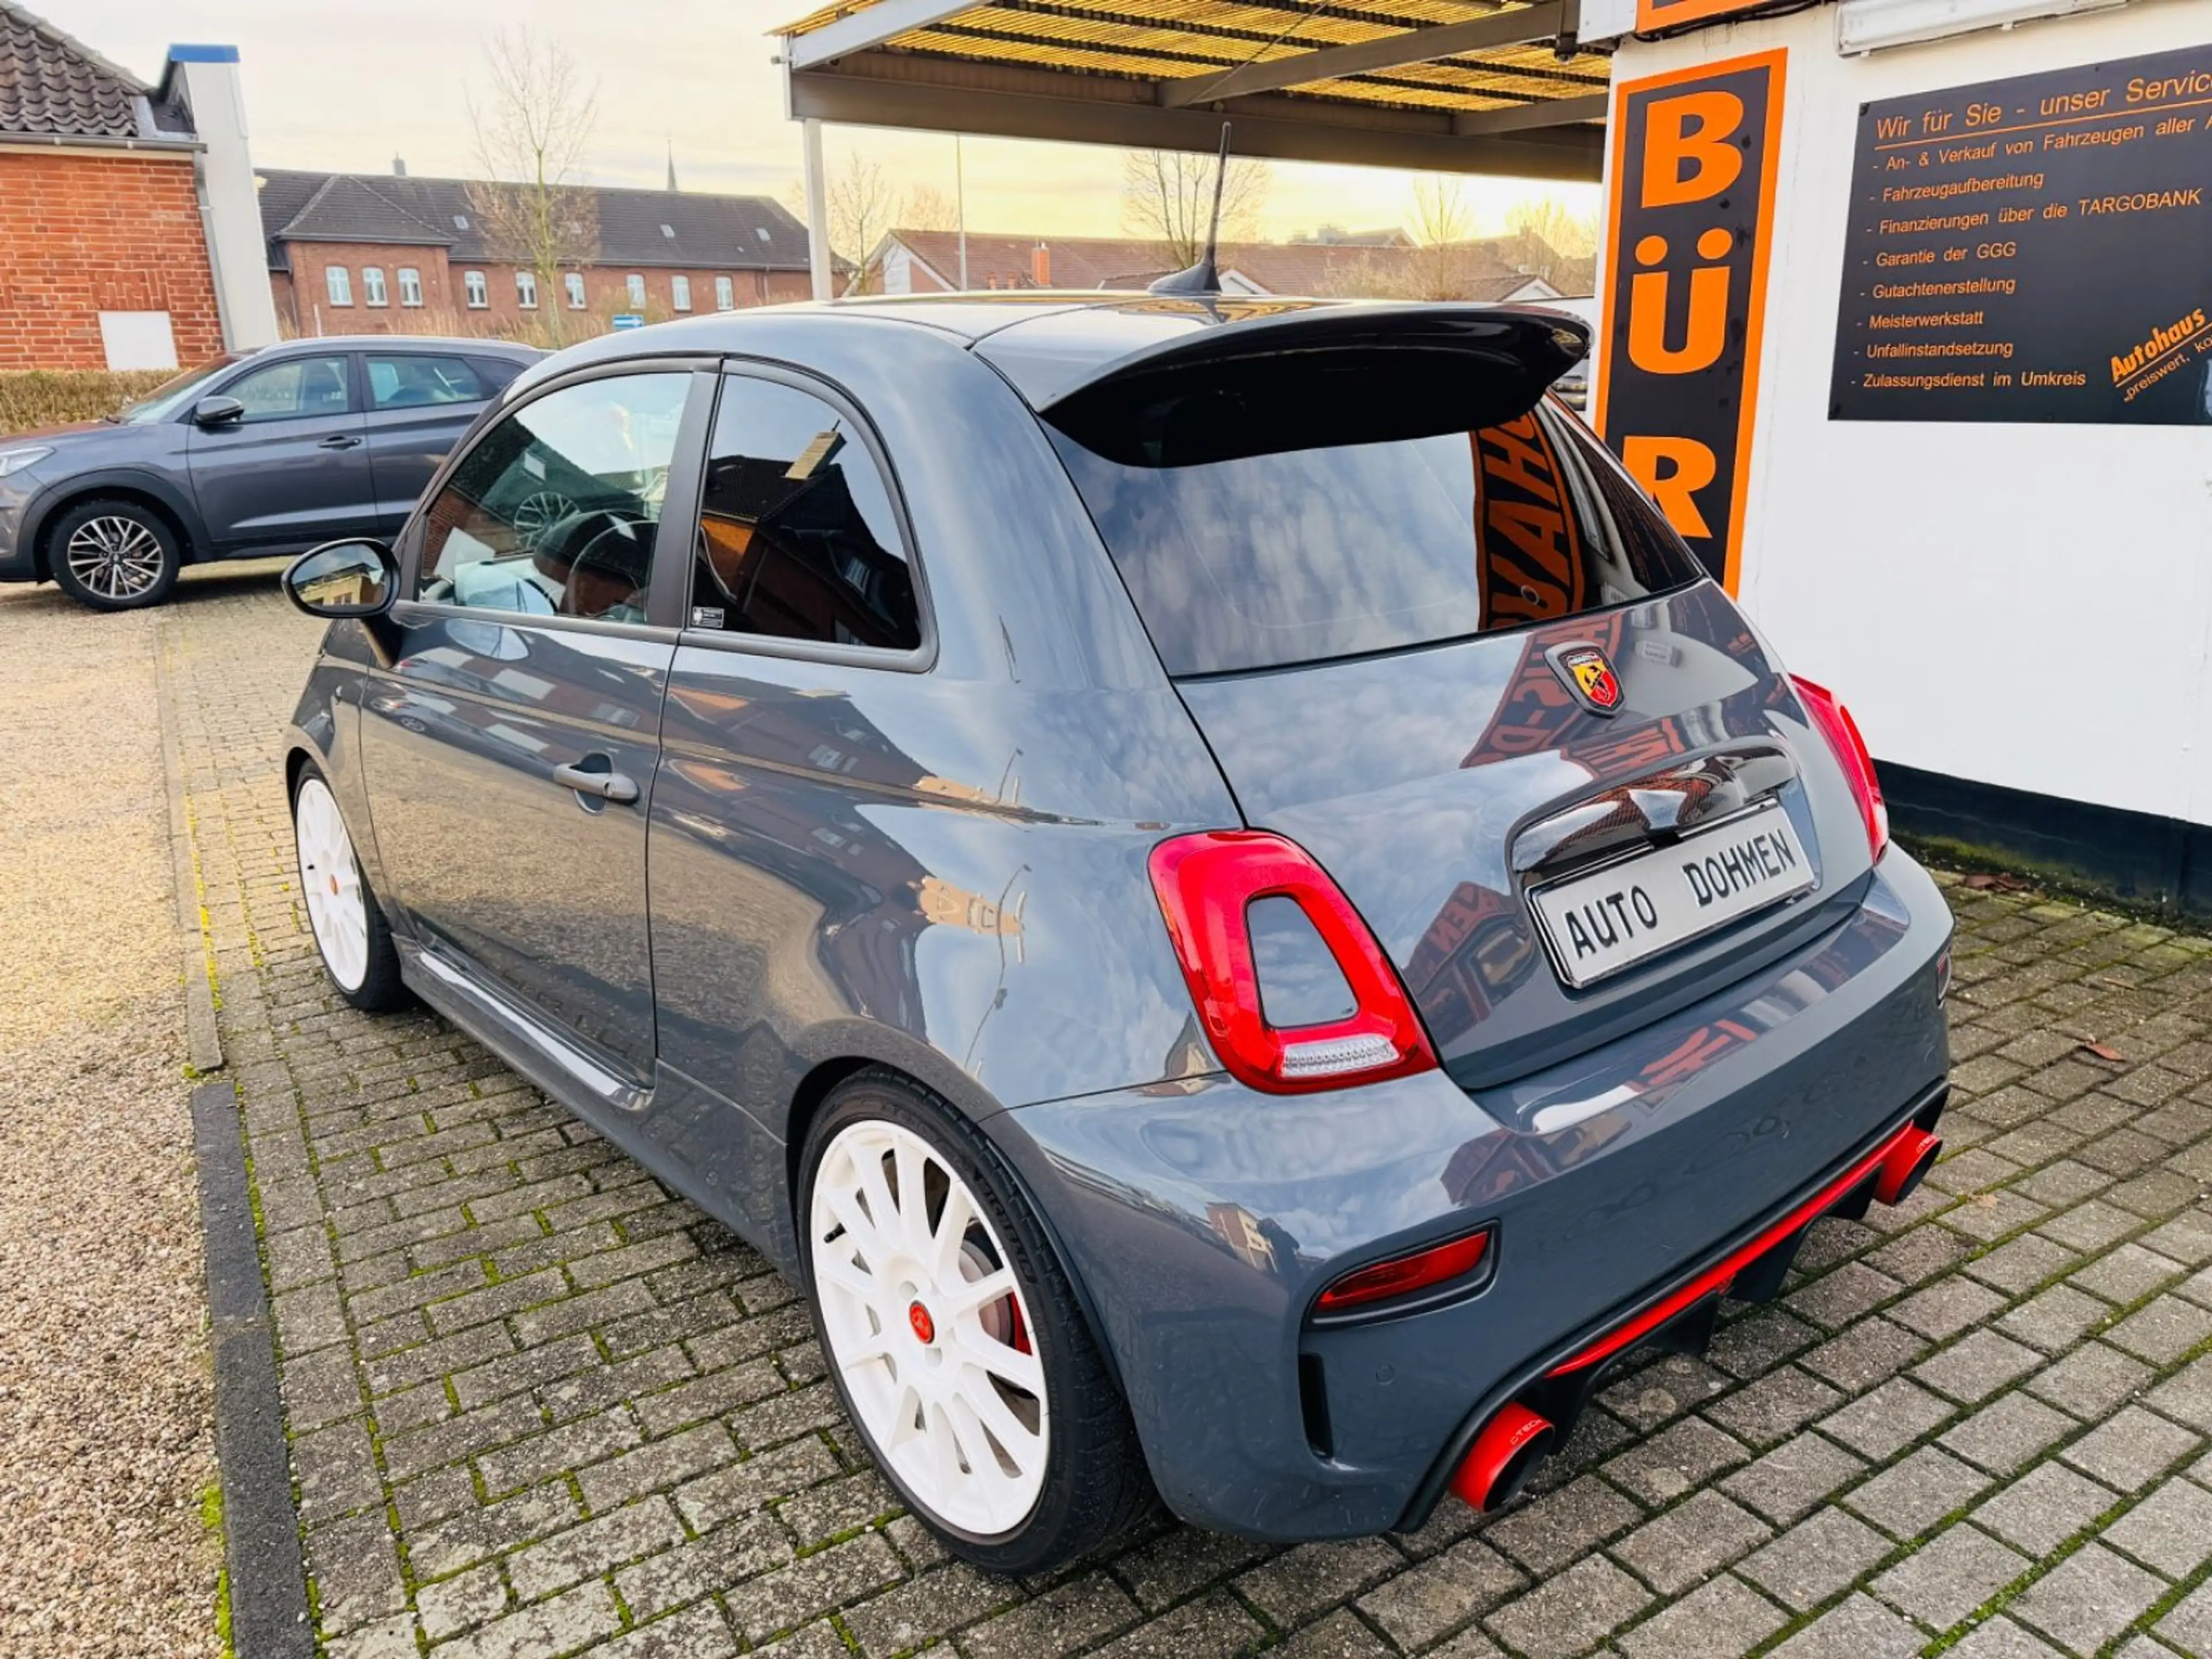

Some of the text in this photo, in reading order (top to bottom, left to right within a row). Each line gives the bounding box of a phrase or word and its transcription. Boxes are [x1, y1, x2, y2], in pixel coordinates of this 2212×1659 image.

[1877, 116, 1911, 139] Wir
[1923, 109, 1953, 133] für
[1965, 102, 2002, 127] Sie
[2040, 89, 2111, 116] unser
[2126, 70, 2212, 102] Servic
[1885, 156, 1910, 171] An-
[1919, 151, 1929, 166] &
[1939, 141, 1997, 164] Verkauf
[2005, 140, 2033, 154] von
[2043, 126, 2144, 150] Fahrzeugen
[2155, 118, 2195, 136] aller
[1883, 173, 2044, 202] Fahrzeugaufbereitung
[1880, 213, 1989, 234] Finanzierungen
[1998, 207, 2035, 223] über
[2043, 203, 2067, 219] die
[2079, 188, 2203, 216] TARGOBANK
[1876, 249, 1936, 267] Garantie
[1943, 247, 1968, 262] der
[1977, 241, 2016, 259] GGG
[1873, 277, 2016, 300] Gutachtenerstellung
[1869, 310, 1983, 329] Meisterwerkstatt
[1866, 342, 2014, 358] Unfallinstandsetzung
[2111, 308, 2205, 382] Autohaus
[1863, 373, 1985, 390] Zulassungsdienst
[1993, 373, 2012, 387] im
[2021, 370, 2086, 387] Umkreis
[1565, 886, 1658, 959] AUTO
[1683, 828, 1796, 906] DOHMEN
